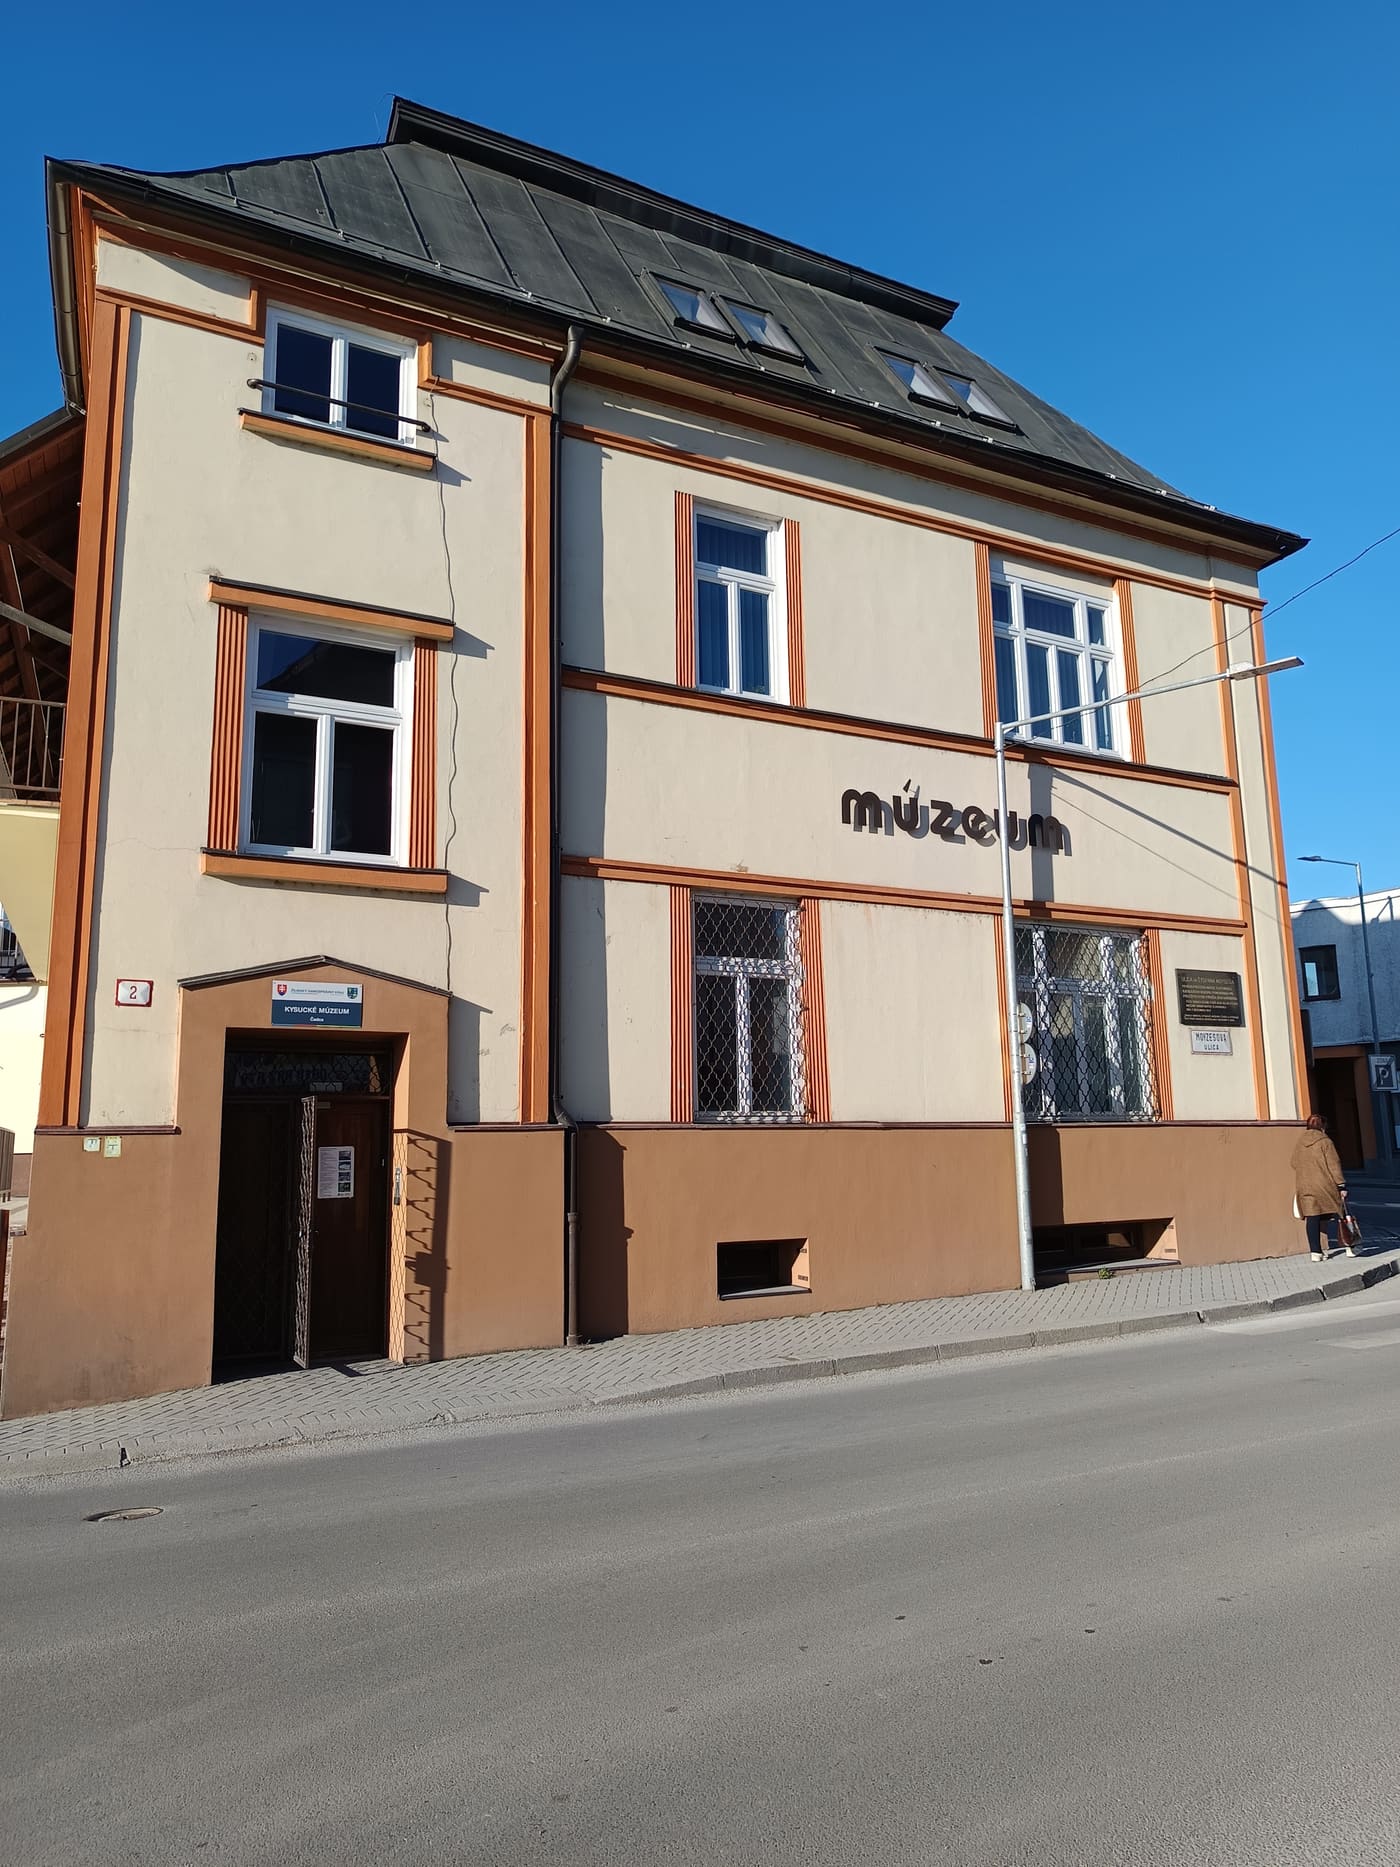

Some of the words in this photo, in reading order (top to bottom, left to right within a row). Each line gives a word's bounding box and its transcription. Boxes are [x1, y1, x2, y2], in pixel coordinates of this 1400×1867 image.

[841, 779, 1064, 850] múzeum
[129, 985, 138, 1000] 2
[284, 1006, 317, 1014] KYSUCKÉ
[318, 1006, 350, 1014] MÚZEUM
